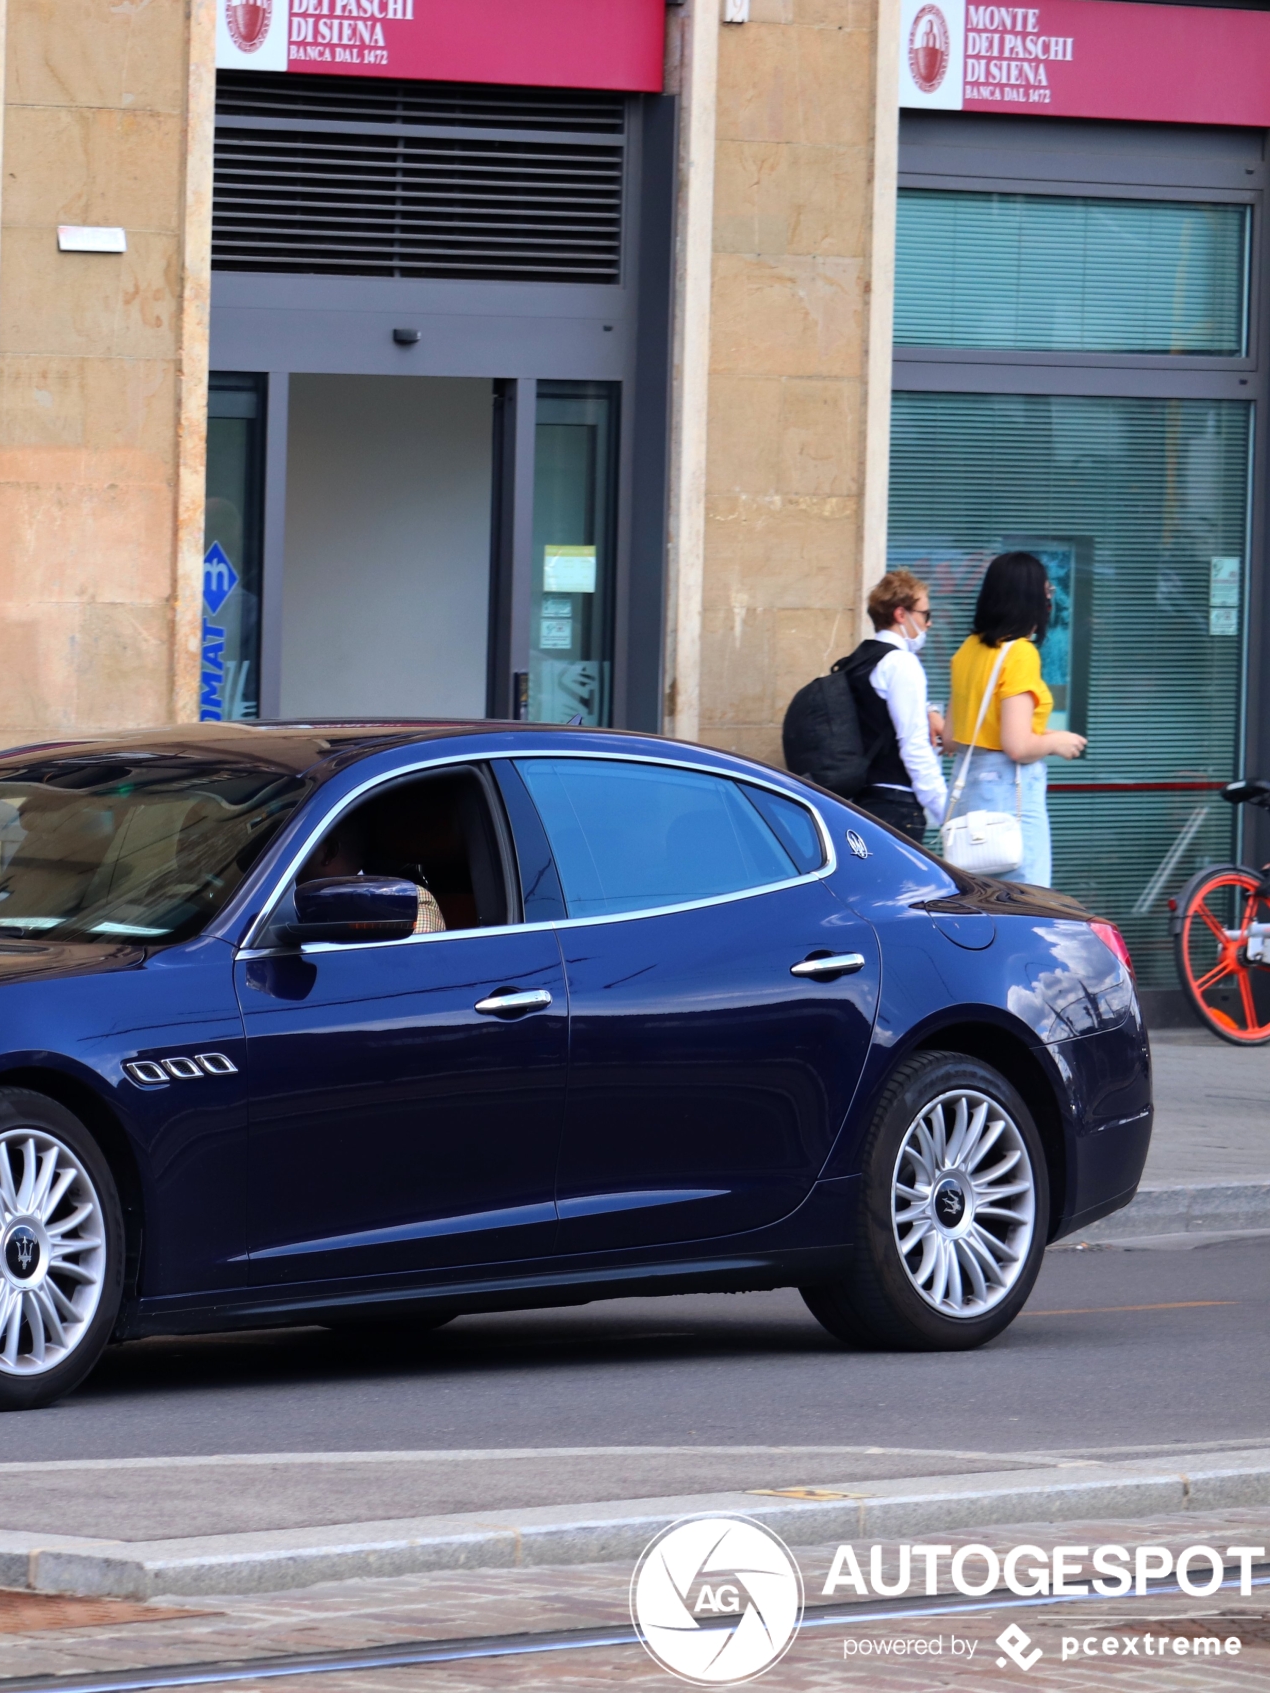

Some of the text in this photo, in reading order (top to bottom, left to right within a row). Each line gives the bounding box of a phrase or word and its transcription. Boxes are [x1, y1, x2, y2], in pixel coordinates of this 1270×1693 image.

[332, 0, 414, 20] PASCHI
[967, 5, 1039, 32] MONTE
[290, 17, 315, 42] DI
[317, 18, 386, 46] SIENA
[289, 45, 388, 65] BANCA DAL 1472
[966, 32, 1073, 61] DEI PASCHI
[965, 59, 1048, 86] DI SIENA
[965, 85, 1051, 103] BANCA DAL 1472
